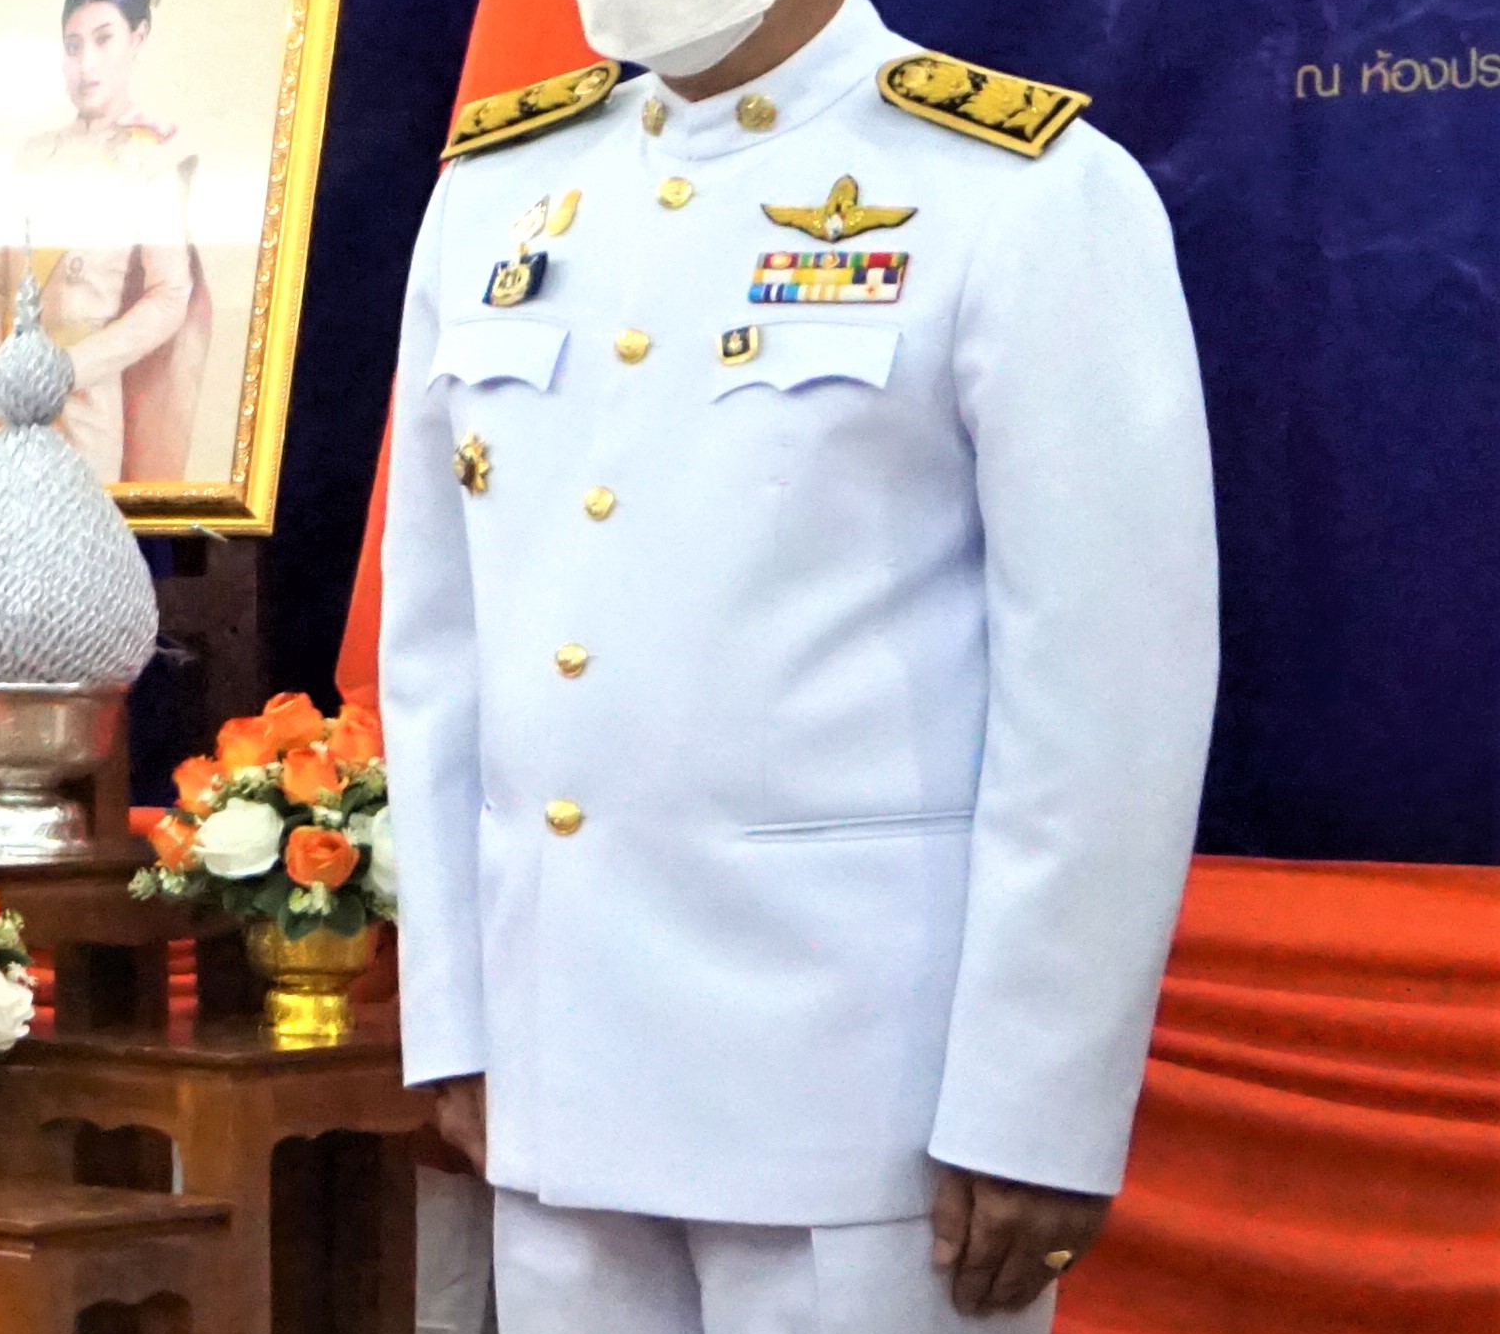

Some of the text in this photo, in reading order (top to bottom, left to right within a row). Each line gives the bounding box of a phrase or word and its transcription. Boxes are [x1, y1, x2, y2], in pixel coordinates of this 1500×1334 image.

[1296, 47, 1500, 99] ณ ห้องปร
